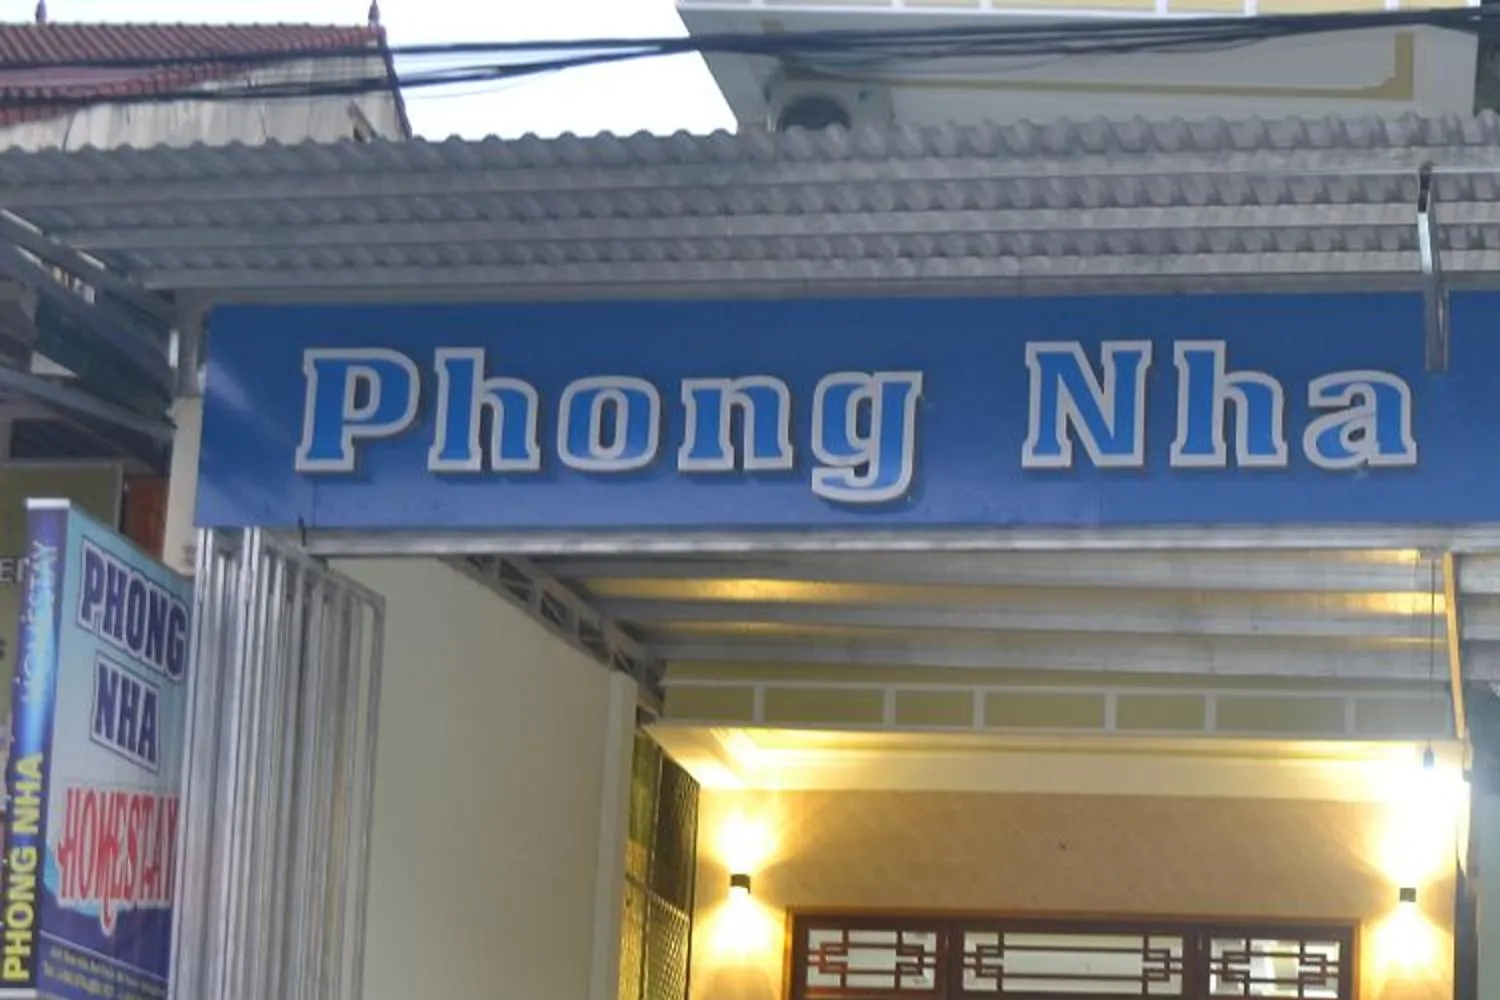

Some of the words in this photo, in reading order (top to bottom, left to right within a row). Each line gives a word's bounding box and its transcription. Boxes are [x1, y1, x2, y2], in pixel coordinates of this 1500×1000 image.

[296, 348, 923, 500] Phong
[1021, 340, 1417, 469] Nha
[79, 540, 188, 680] PHONG
[92, 662, 159, 770] NHA
[12, 752, 45, 834] NHA
[57, 786, 180, 929] HOMESTAY
[2, 844, 37, 981] PHONG
